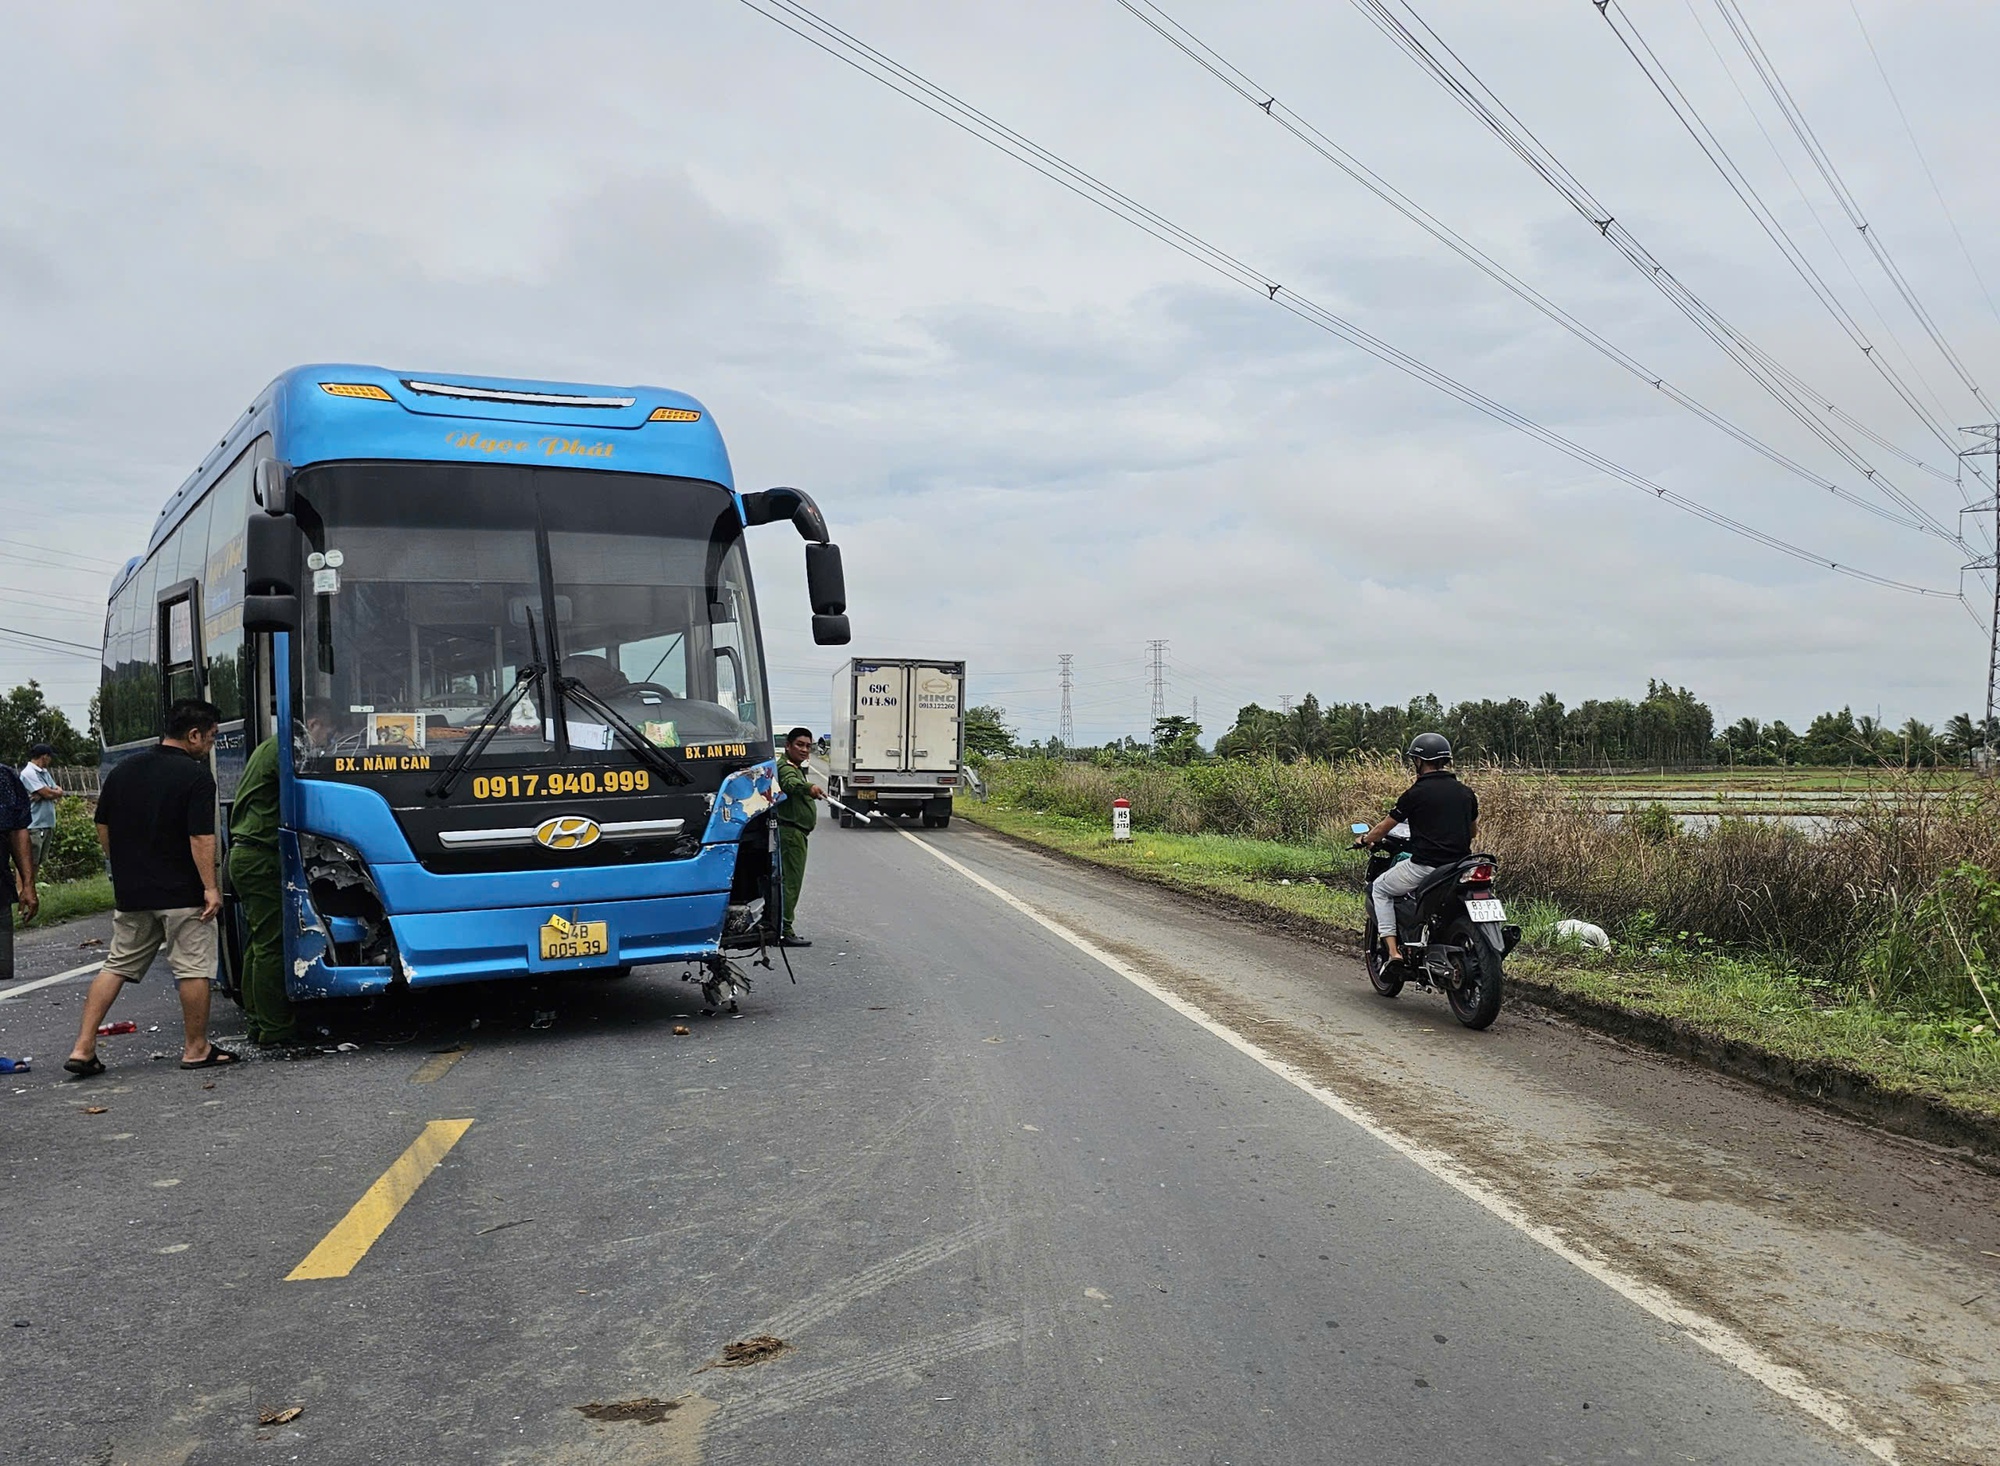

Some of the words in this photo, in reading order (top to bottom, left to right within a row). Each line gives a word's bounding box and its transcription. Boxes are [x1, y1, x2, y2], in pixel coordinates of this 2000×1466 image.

[445, 430, 530, 454] Ngọc
[538, 437, 615, 458] Phát
[869, 684, 890, 694] 69C
[861, 696, 897, 706] 014.80
[918, 694, 956, 702] HINO
[685, 746, 705, 759] BX.
[707, 744, 723, 758] AN
[335, 757, 360, 772] BX.
[363, 754, 397, 771] NĂM
[473, 770, 649, 799] 0917.940.999
[555, 917, 568, 930] 14
